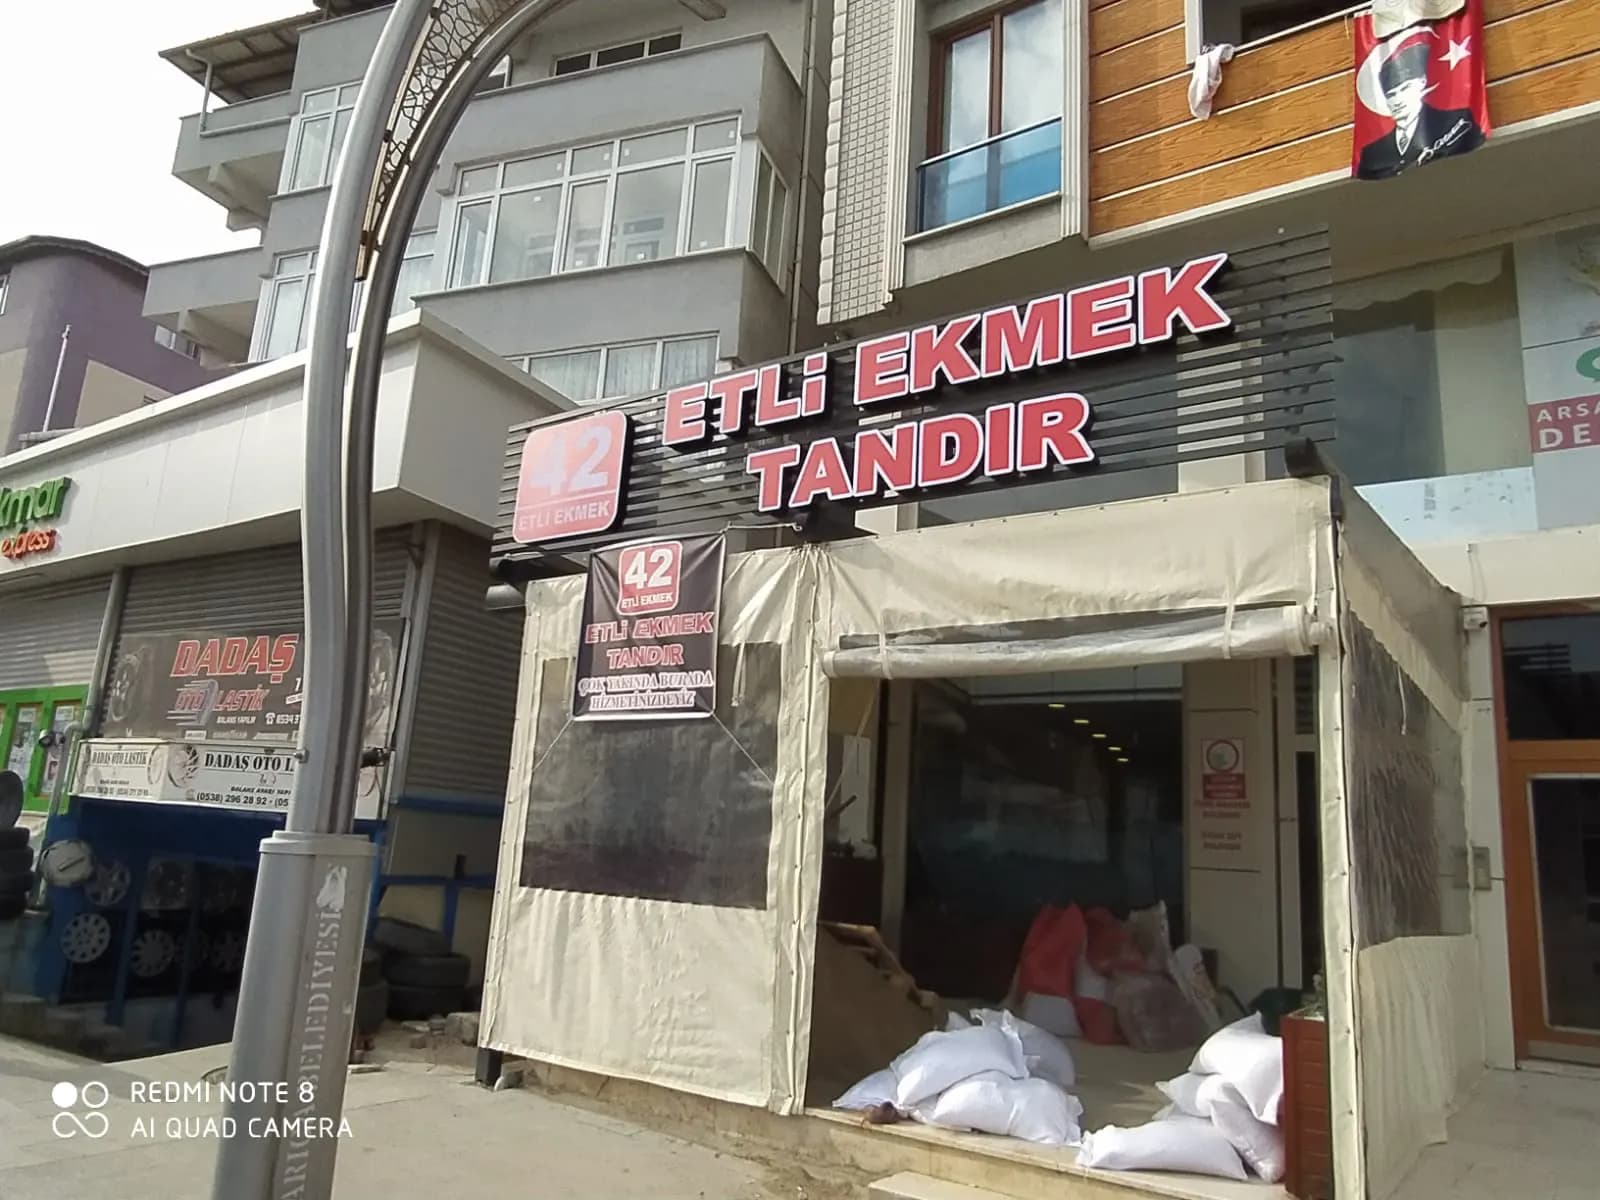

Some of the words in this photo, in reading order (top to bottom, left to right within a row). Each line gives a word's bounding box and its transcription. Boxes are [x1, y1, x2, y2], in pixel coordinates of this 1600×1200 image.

[853, 252, 1233, 406] EKMEK
[529, 425, 613, 497] 42
[746, 392, 1095, 512] TANDIR
[553, 499, 611, 526] EKMEK
[623, 548, 674, 590] 42
[640, 591, 674, 606] EKMEK
[632, 611, 715, 639] EKMEK
[169, 632, 300, 684] DADAŞ
[606, 643, 685, 670] TANDIR
[578, 676, 606, 697] ÇOK
[606, 673, 658, 692] YAKINDA
[658, 669, 715, 691] BURADA
[211, 683, 271, 712] LASTİK
[204, 752, 250, 772] DADAŞ
[252, 756, 282, 771] OTO
[196, 791, 224, 804] (0538)
[224, 794, 241, 804] 296
[242, 795, 254, 805] 28
[256, 796, 268, 806] 92
